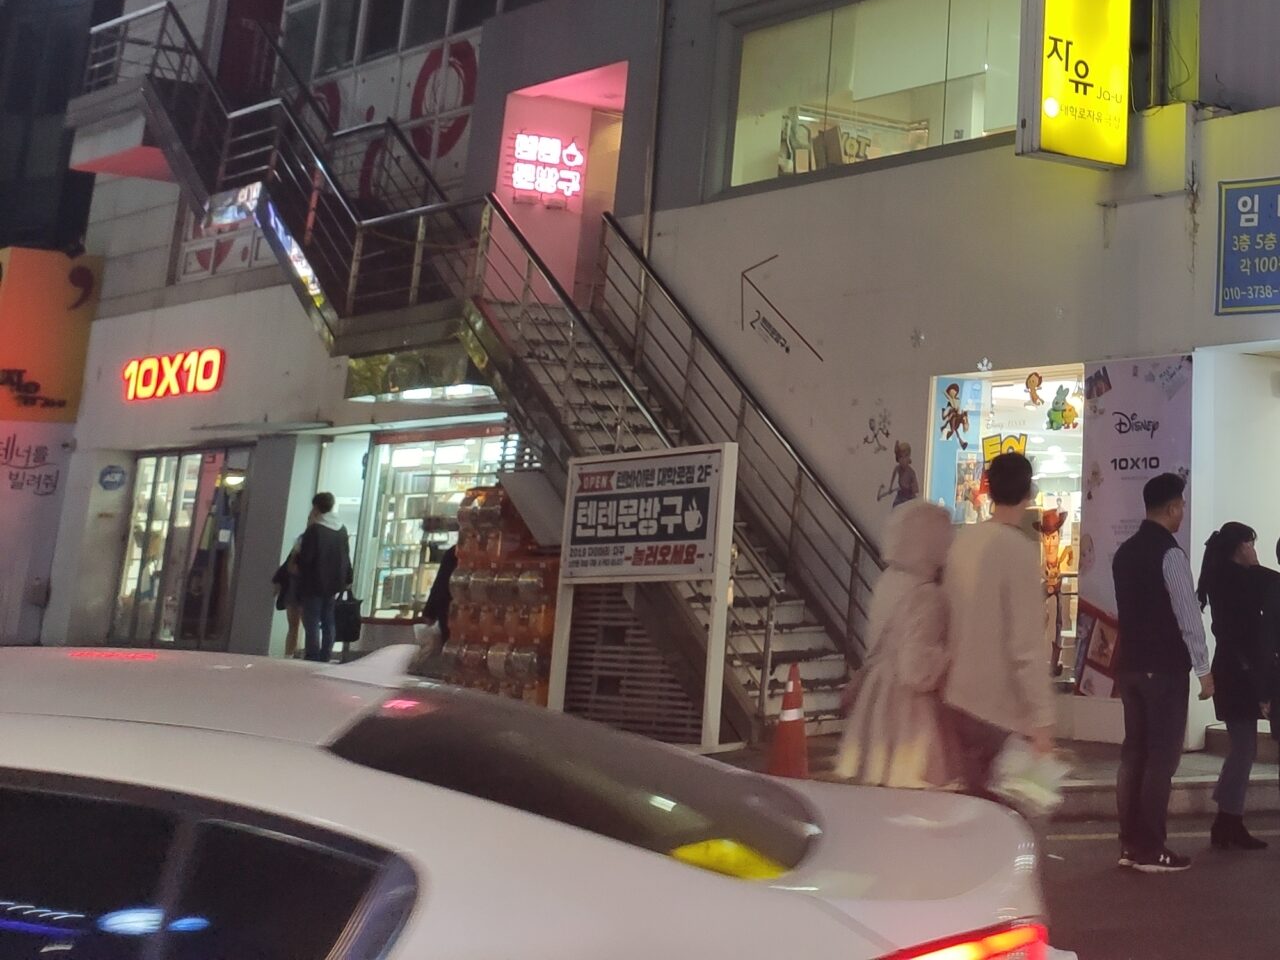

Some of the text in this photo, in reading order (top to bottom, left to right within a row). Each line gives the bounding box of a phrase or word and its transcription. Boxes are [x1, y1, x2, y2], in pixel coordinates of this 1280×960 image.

[1046, 35, 1095, 96] 자유
[1232, 233, 1251, 253] 3층
[1254, 232, 1278, 251] 5층
[1240, 258, 1251, 276] 각
[122, 347, 223, 401] 10X10
[1112, 411, 1160, 440] Disney
[1110, 456, 1160, 471] 10X10
[582, 474, 608, 490] OPEN
[657, 465, 696, 487] 대학로점
[697, 464, 713, 484] 2F
[575, 496, 684, 539] 텐텐문방구
